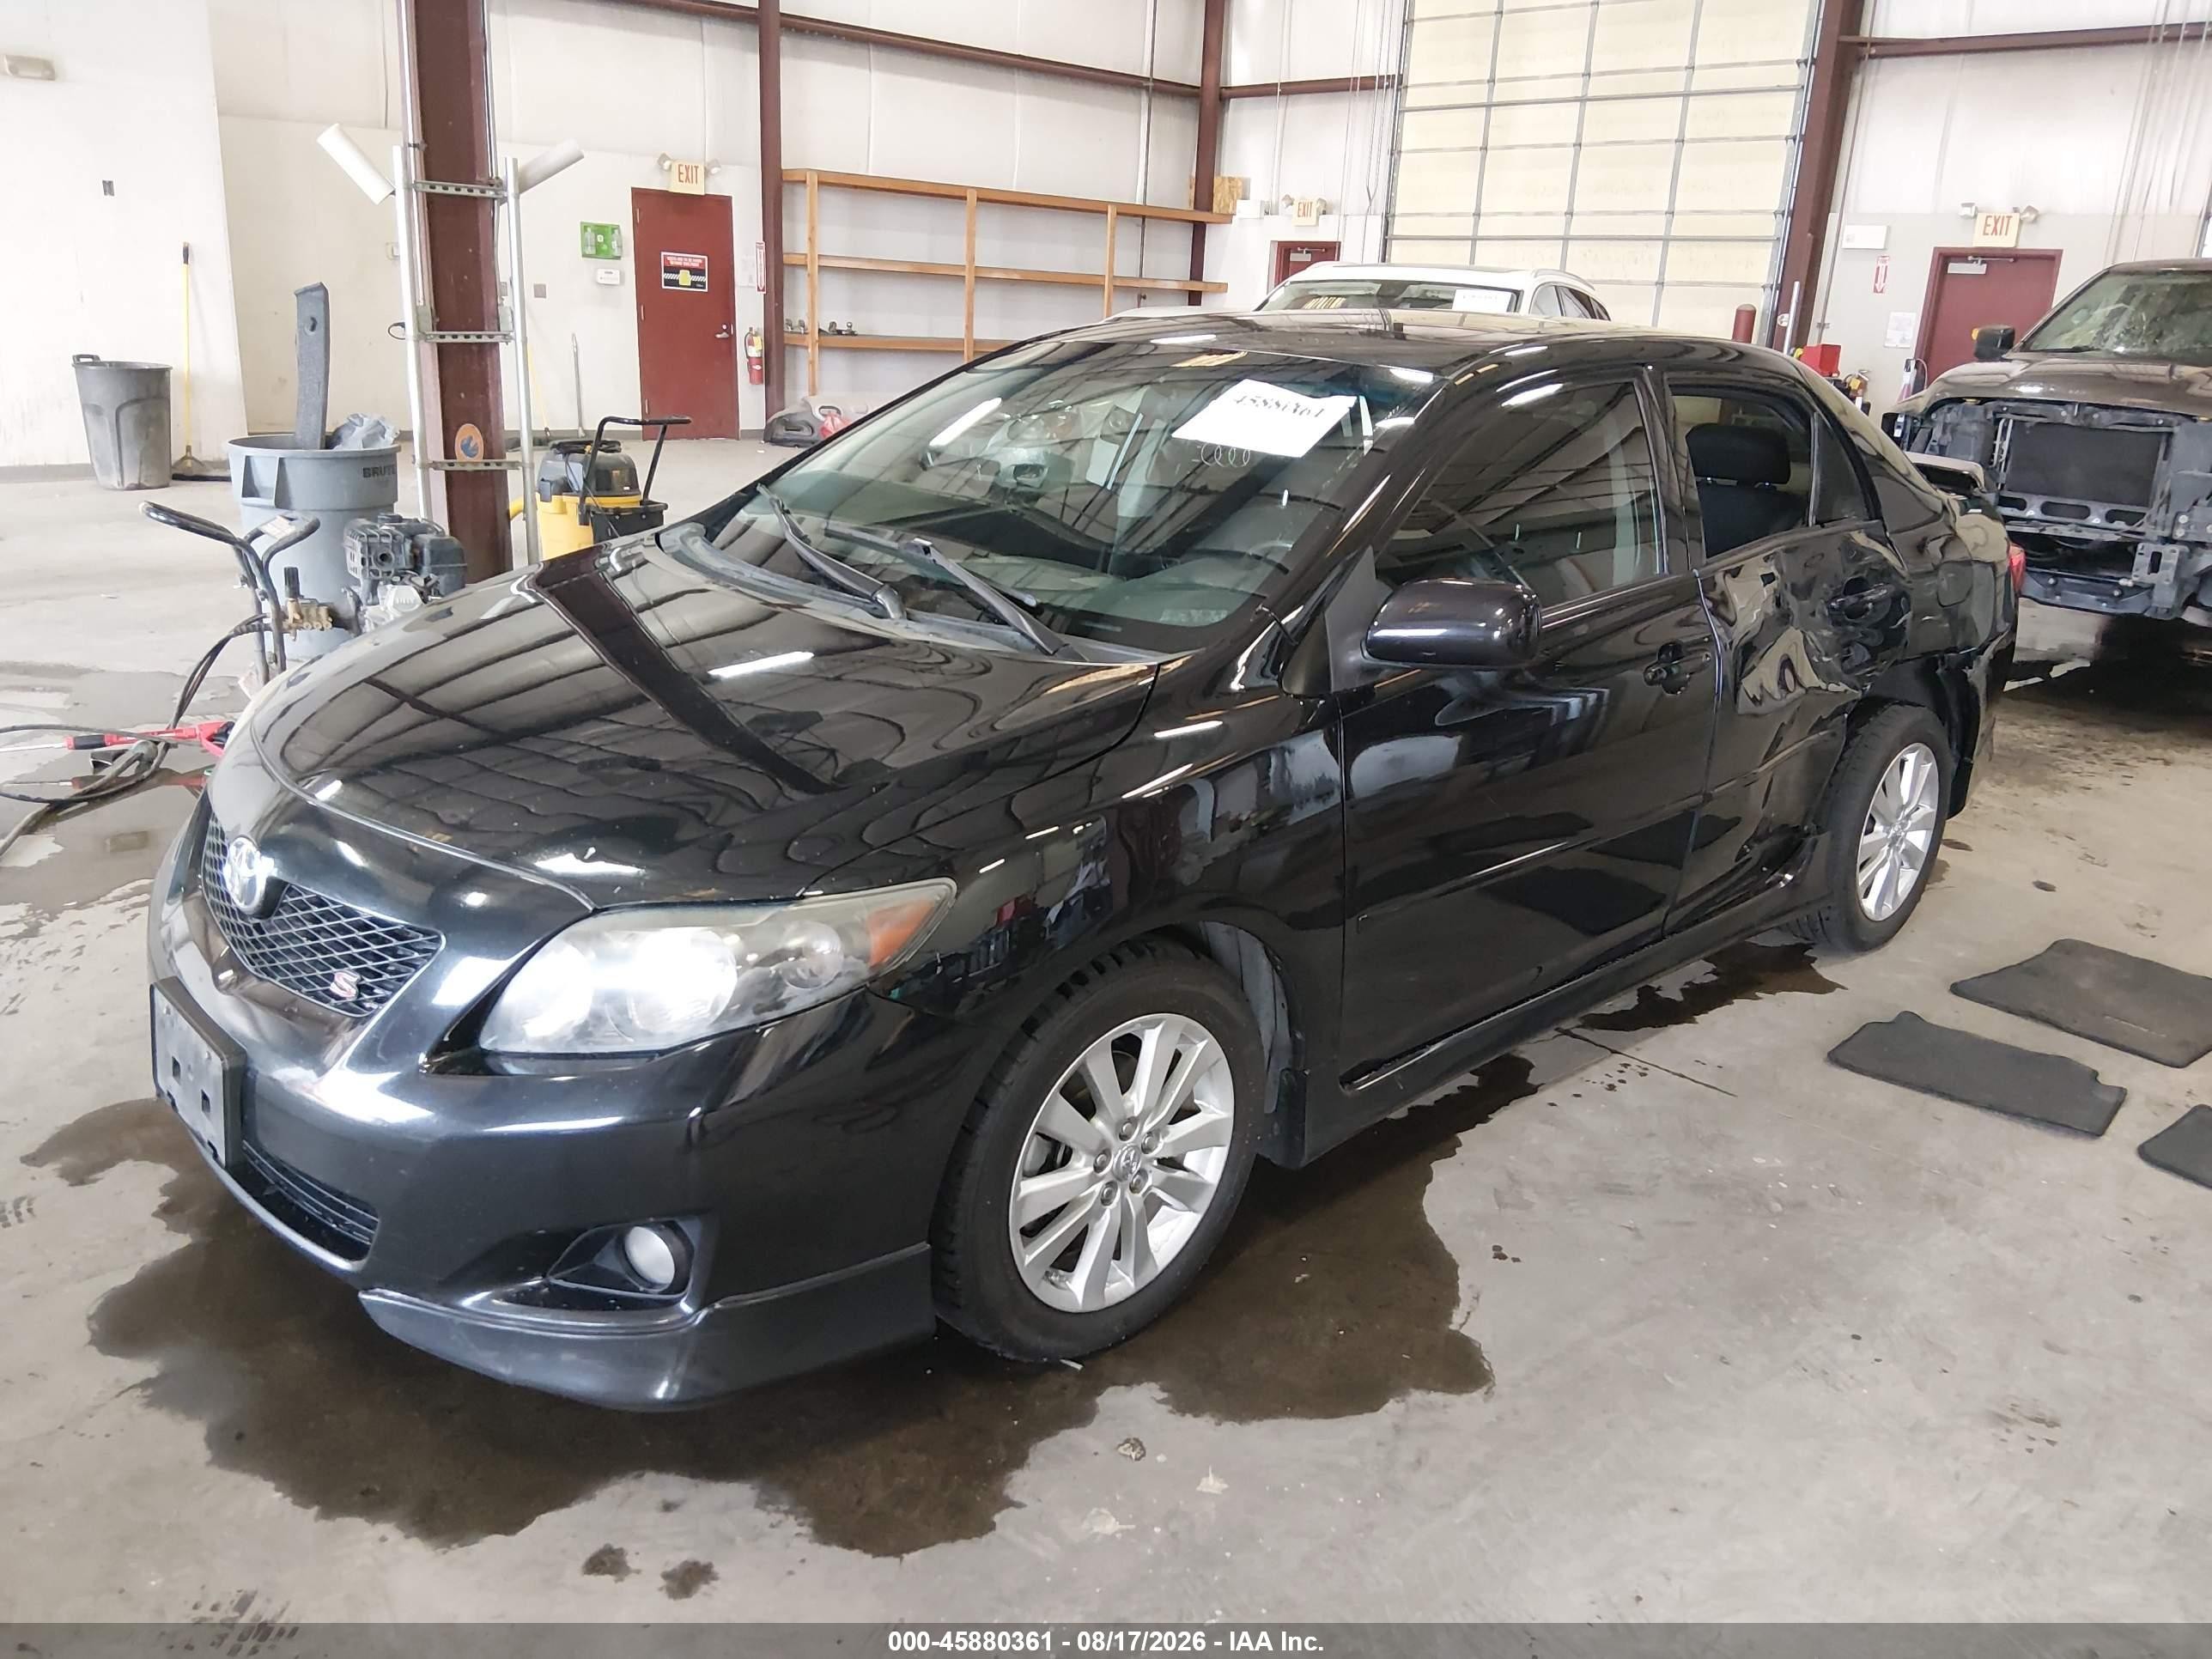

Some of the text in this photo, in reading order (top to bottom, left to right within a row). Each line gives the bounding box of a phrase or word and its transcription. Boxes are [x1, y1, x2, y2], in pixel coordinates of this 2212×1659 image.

[678, 163, 699, 185] EXIT
[1297, 201, 1313, 218] EXIT
[1982, 215, 2014, 236] EXIT
